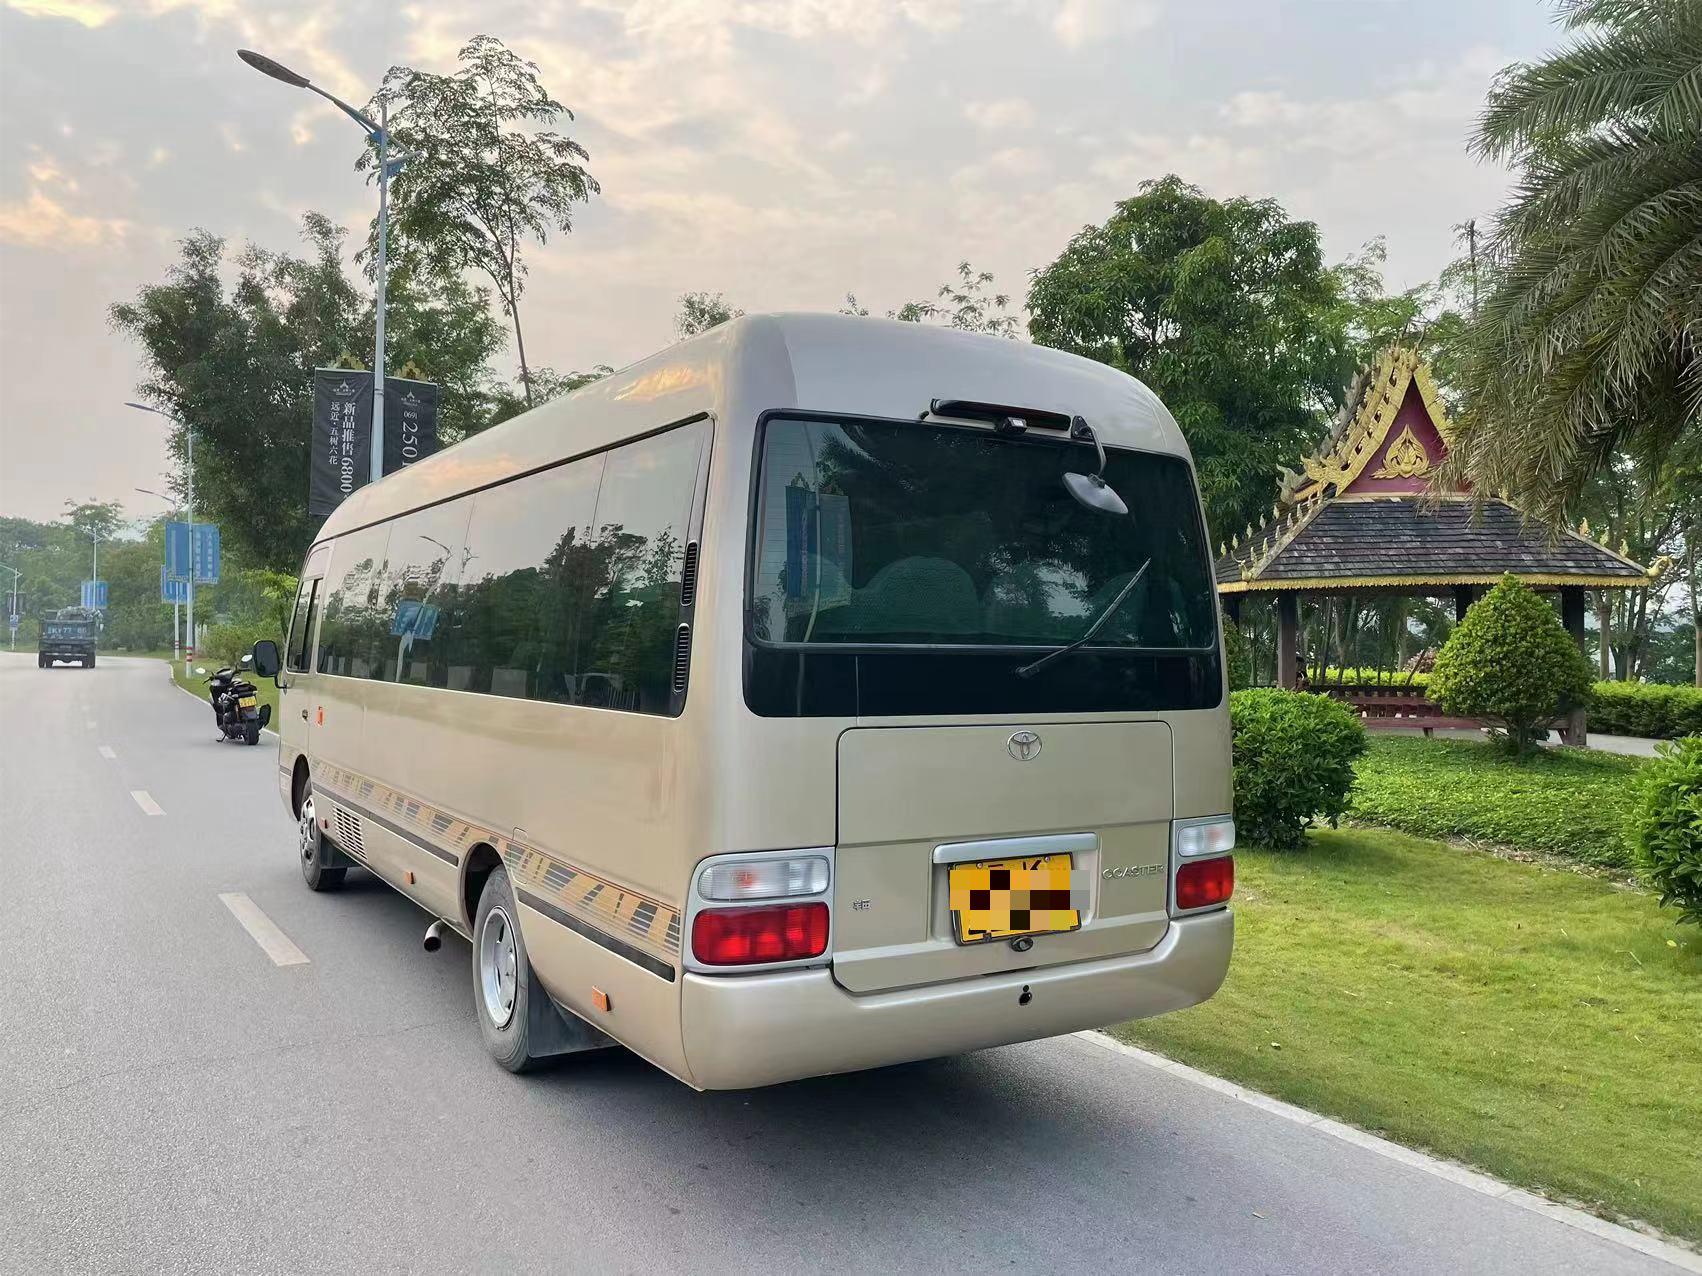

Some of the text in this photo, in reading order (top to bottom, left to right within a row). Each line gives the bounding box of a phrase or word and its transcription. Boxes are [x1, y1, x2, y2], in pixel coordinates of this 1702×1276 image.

[340, 402, 356, 498] 新品推售6800
[1102, 863, 1165, 880] COASTER
